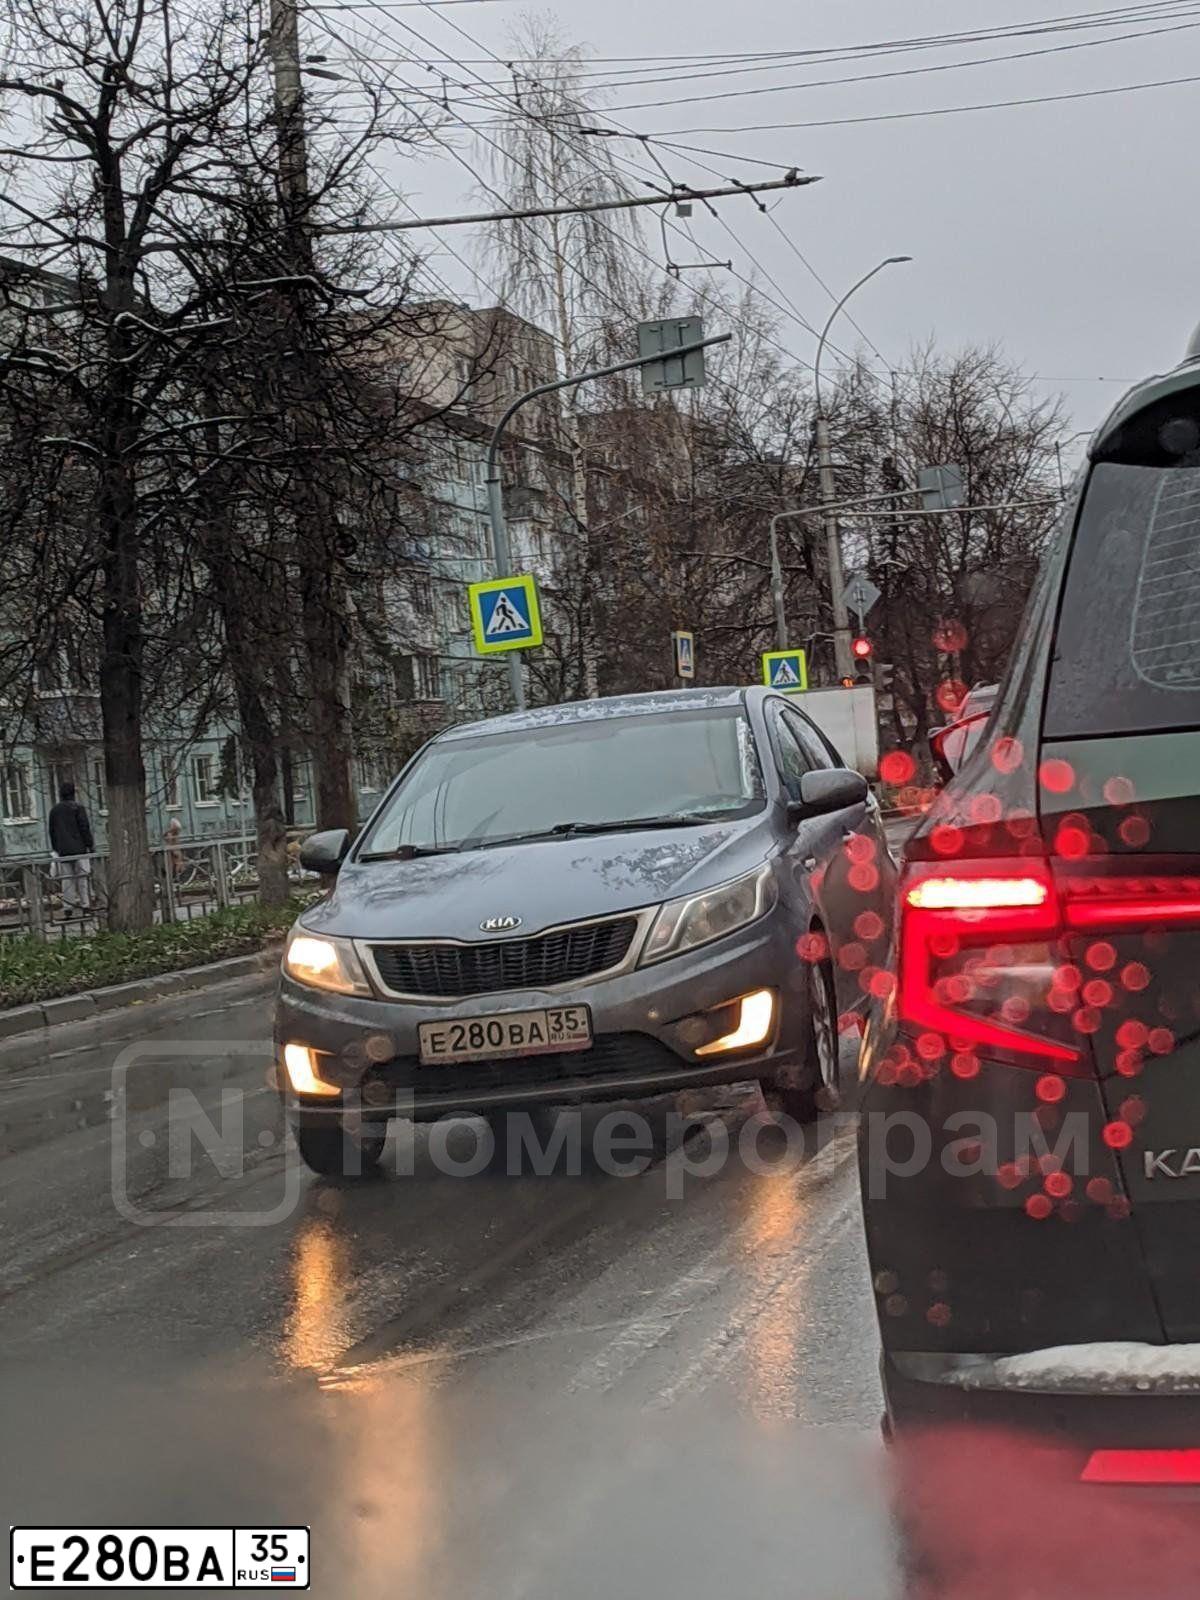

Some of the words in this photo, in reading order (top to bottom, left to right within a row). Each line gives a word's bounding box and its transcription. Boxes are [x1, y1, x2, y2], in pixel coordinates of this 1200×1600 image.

[486, 917, 514, 928] KIA
[430, 1020, 545, 1054] Е280ВА
[550, 1010, 579, 1032] 35
